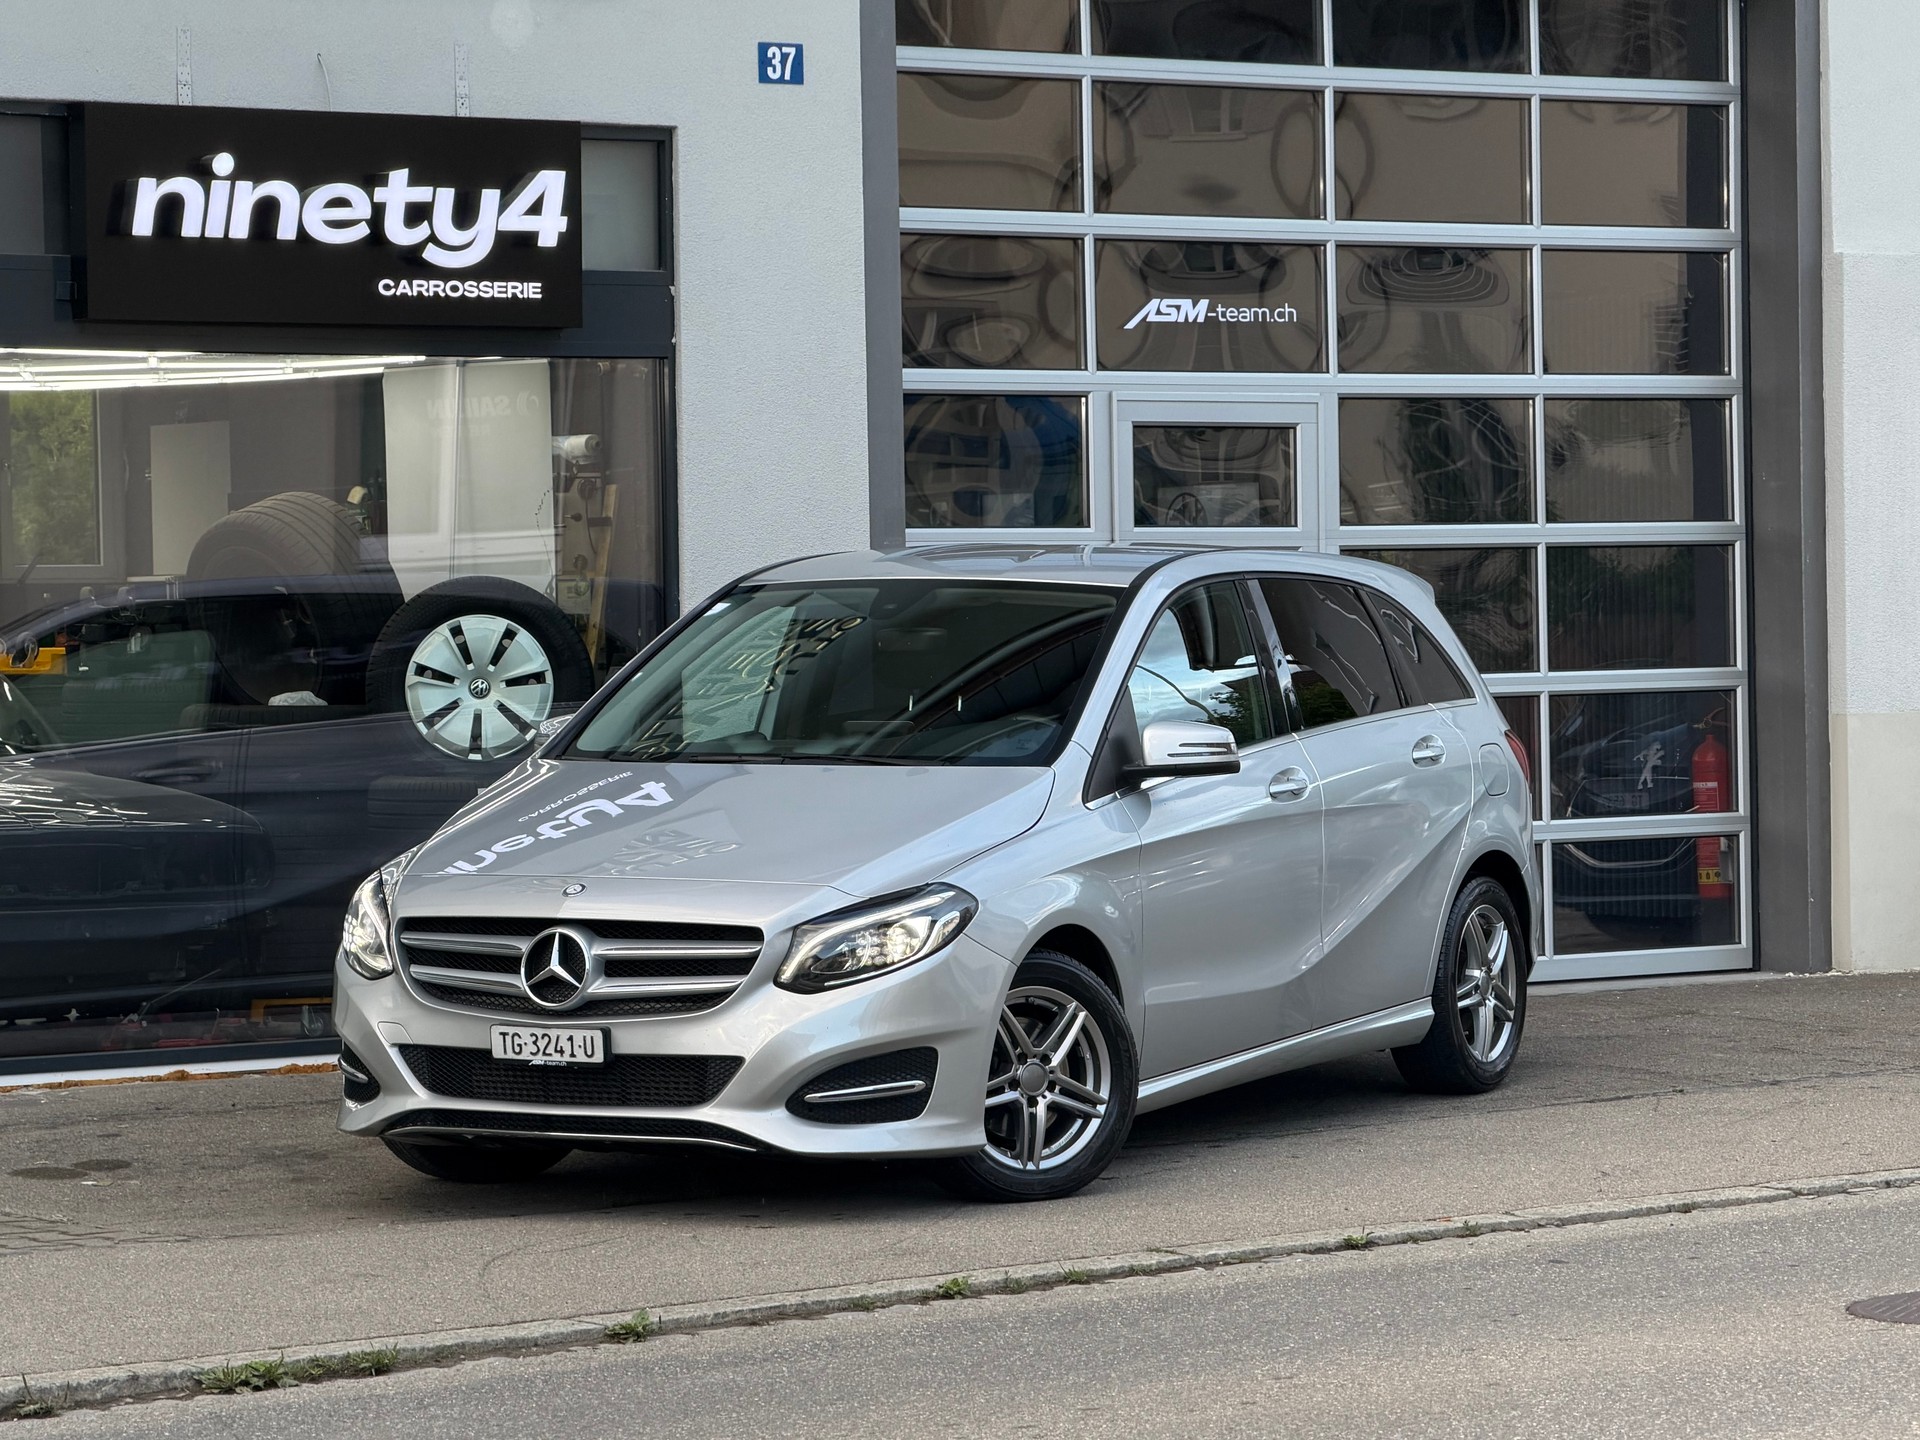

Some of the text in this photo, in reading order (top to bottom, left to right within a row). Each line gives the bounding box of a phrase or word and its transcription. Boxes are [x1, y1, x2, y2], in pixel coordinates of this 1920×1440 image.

[767, 46, 796, 80] 37
[131, 152, 567, 268] ninety4
[378, 279, 542, 298] CARROSSERIE
[1123, 298, 1297, 329] ASM-team.ch
